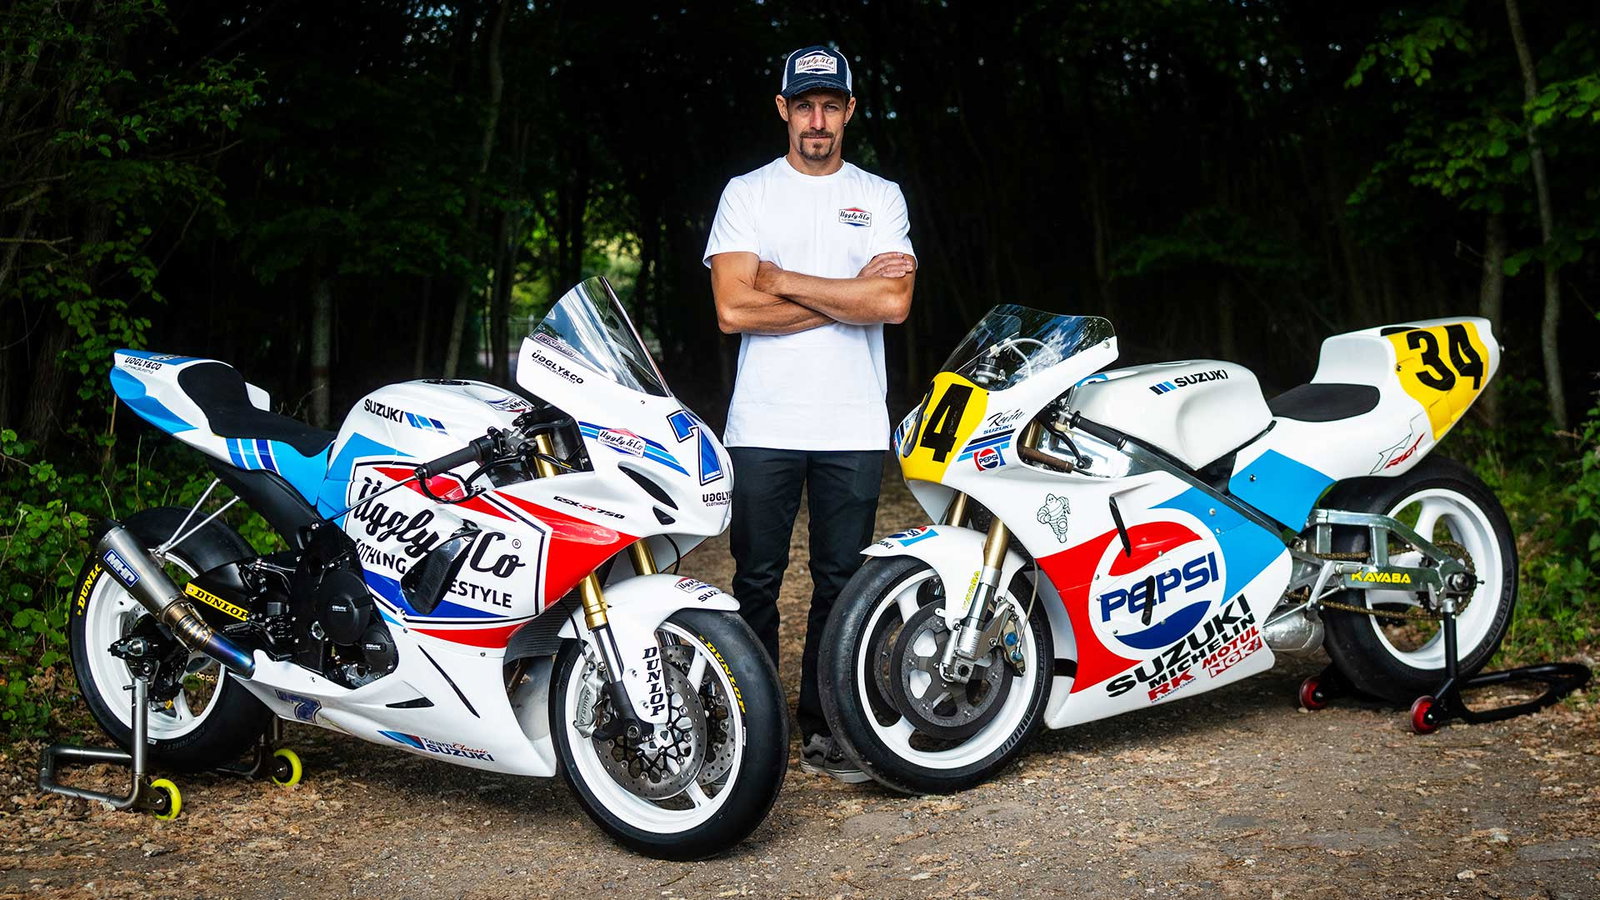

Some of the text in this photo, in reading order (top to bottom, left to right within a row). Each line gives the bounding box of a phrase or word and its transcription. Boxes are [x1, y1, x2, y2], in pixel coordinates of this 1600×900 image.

[1406, 323, 1485, 391] 34
[1173, 369, 1229, 388] SUZUKI
[364, 398, 405, 424] SUZUKI
[983, 423, 1013, 435] SUZUKI
[666, 409, 725, 487] 7
[978, 453, 999, 465] PEPSI
[77, 563, 103, 610] DUNLO
[356, 538, 513, 609] OTHING ESTYLE
[1100, 551, 1220, 623] PEPSI
[1351, 571, 1412, 584] KAYABA
[697, 590, 721, 603] SUZ
[1105, 593, 1252, 698] SUZUKI
[1148, 613, 1256, 690] MICHELIN
[1202, 625, 1260, 670] MOTUL
[1210, 638, 1259, 677] NGK
[642, 646, 666, 717] DUNLOP
[706, 641, 747, 714] DUNLOP
[1147, 668, 1195, 701] RK
[421, 736, 453, 749] Team
[425, 743, 496, 762] SUZUKI
